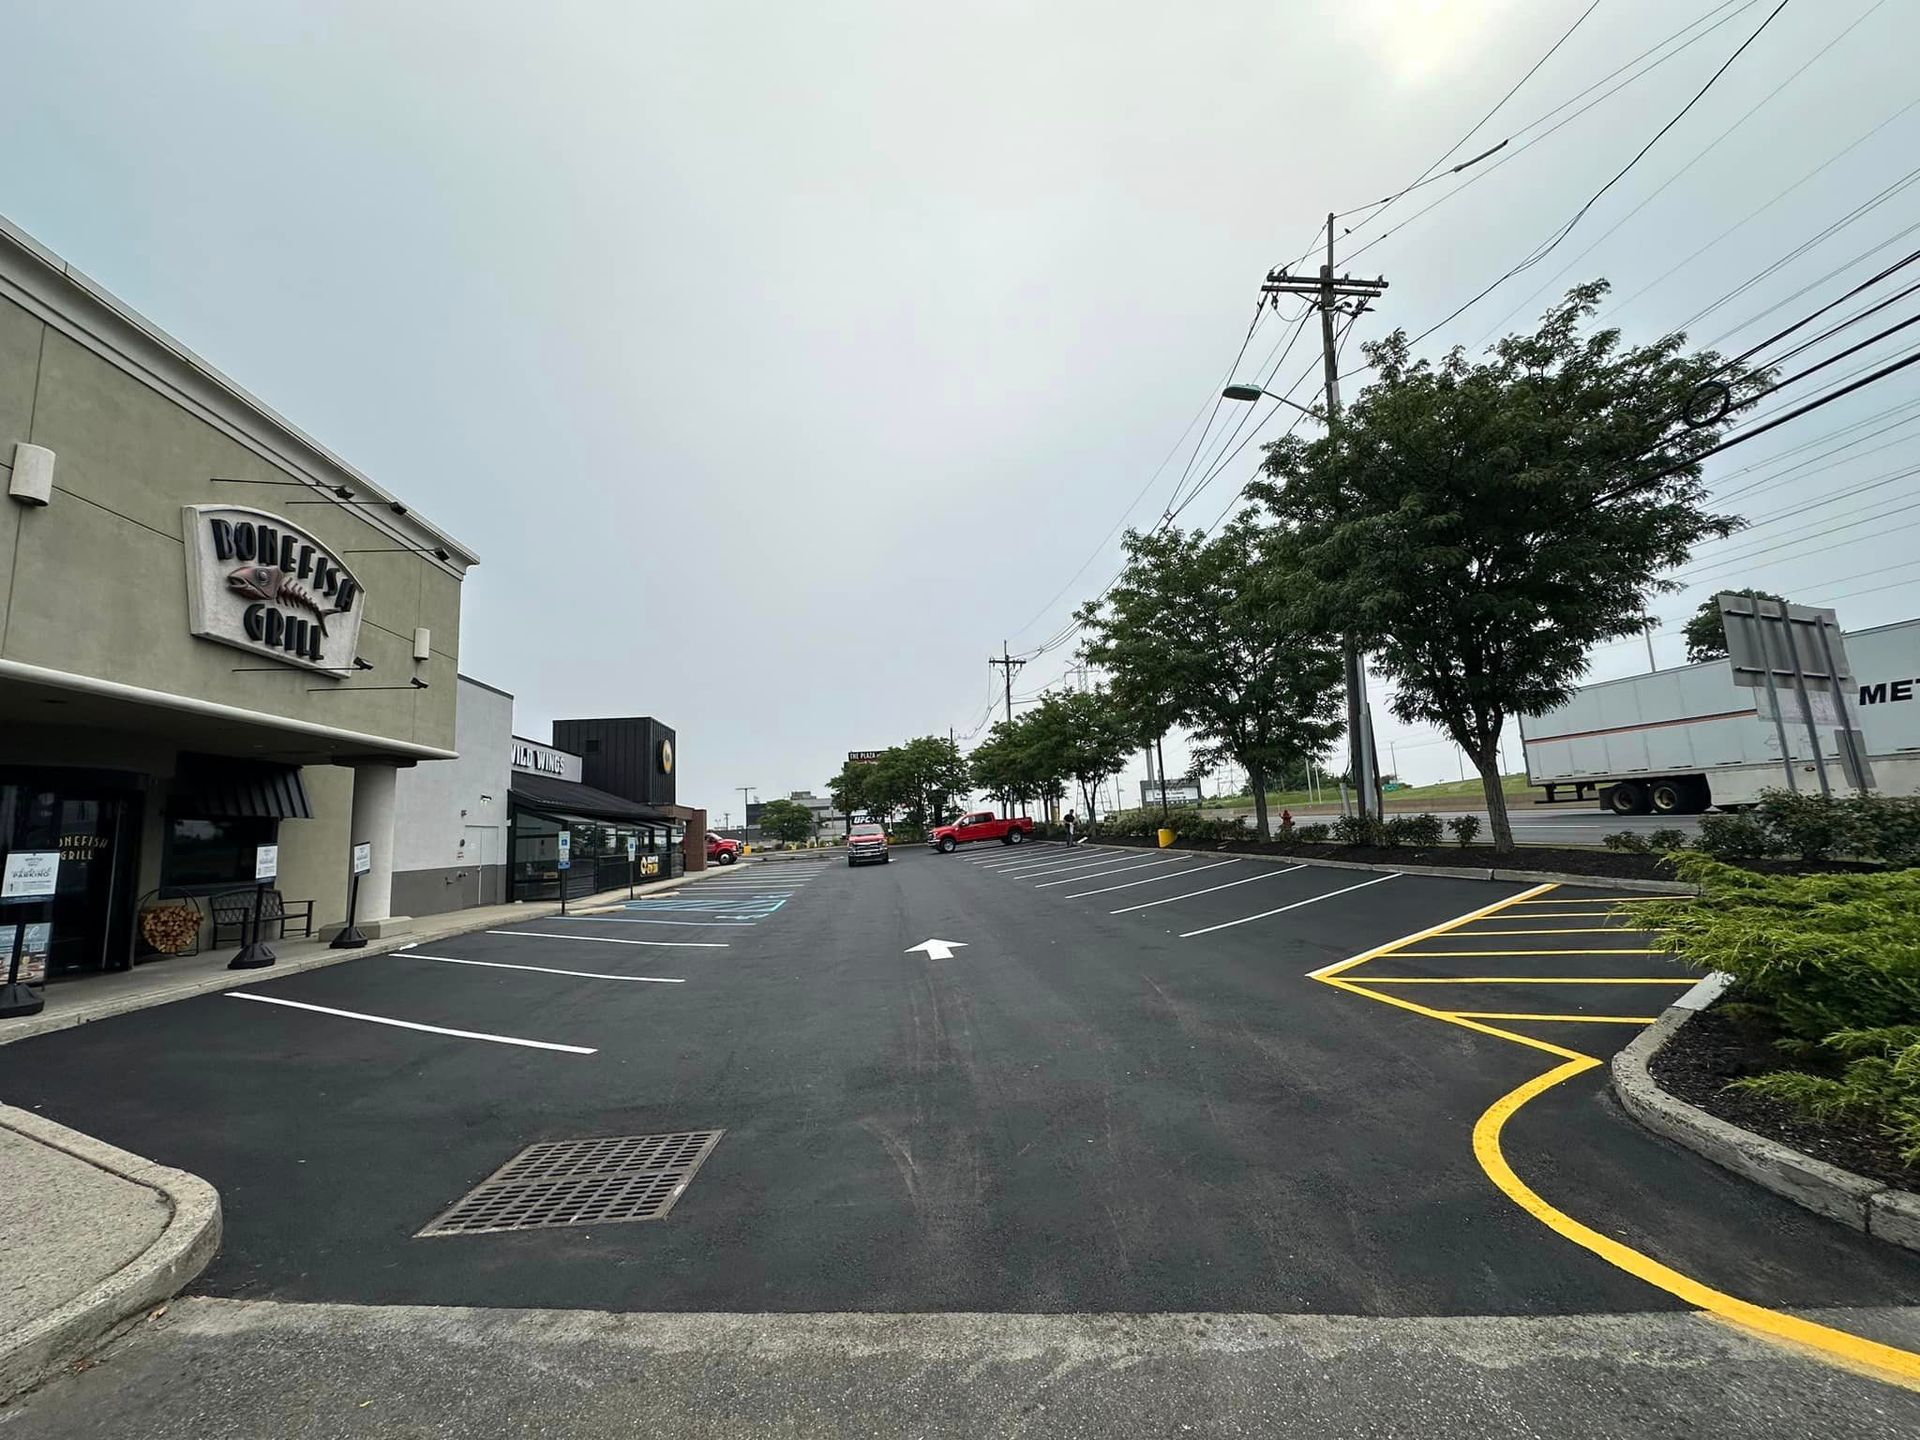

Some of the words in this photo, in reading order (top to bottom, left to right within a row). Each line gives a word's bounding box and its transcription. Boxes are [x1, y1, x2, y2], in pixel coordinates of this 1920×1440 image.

[209, 518, 356, 612] BONEFISH
[243, 603, 325, 661] GRILL
[1859, 678, 1920, 706] ME
[535, 748, 565, 774] WINGS
[853, 816, 871, 824] UFC
[60, 850, 94, 861] GRILL
